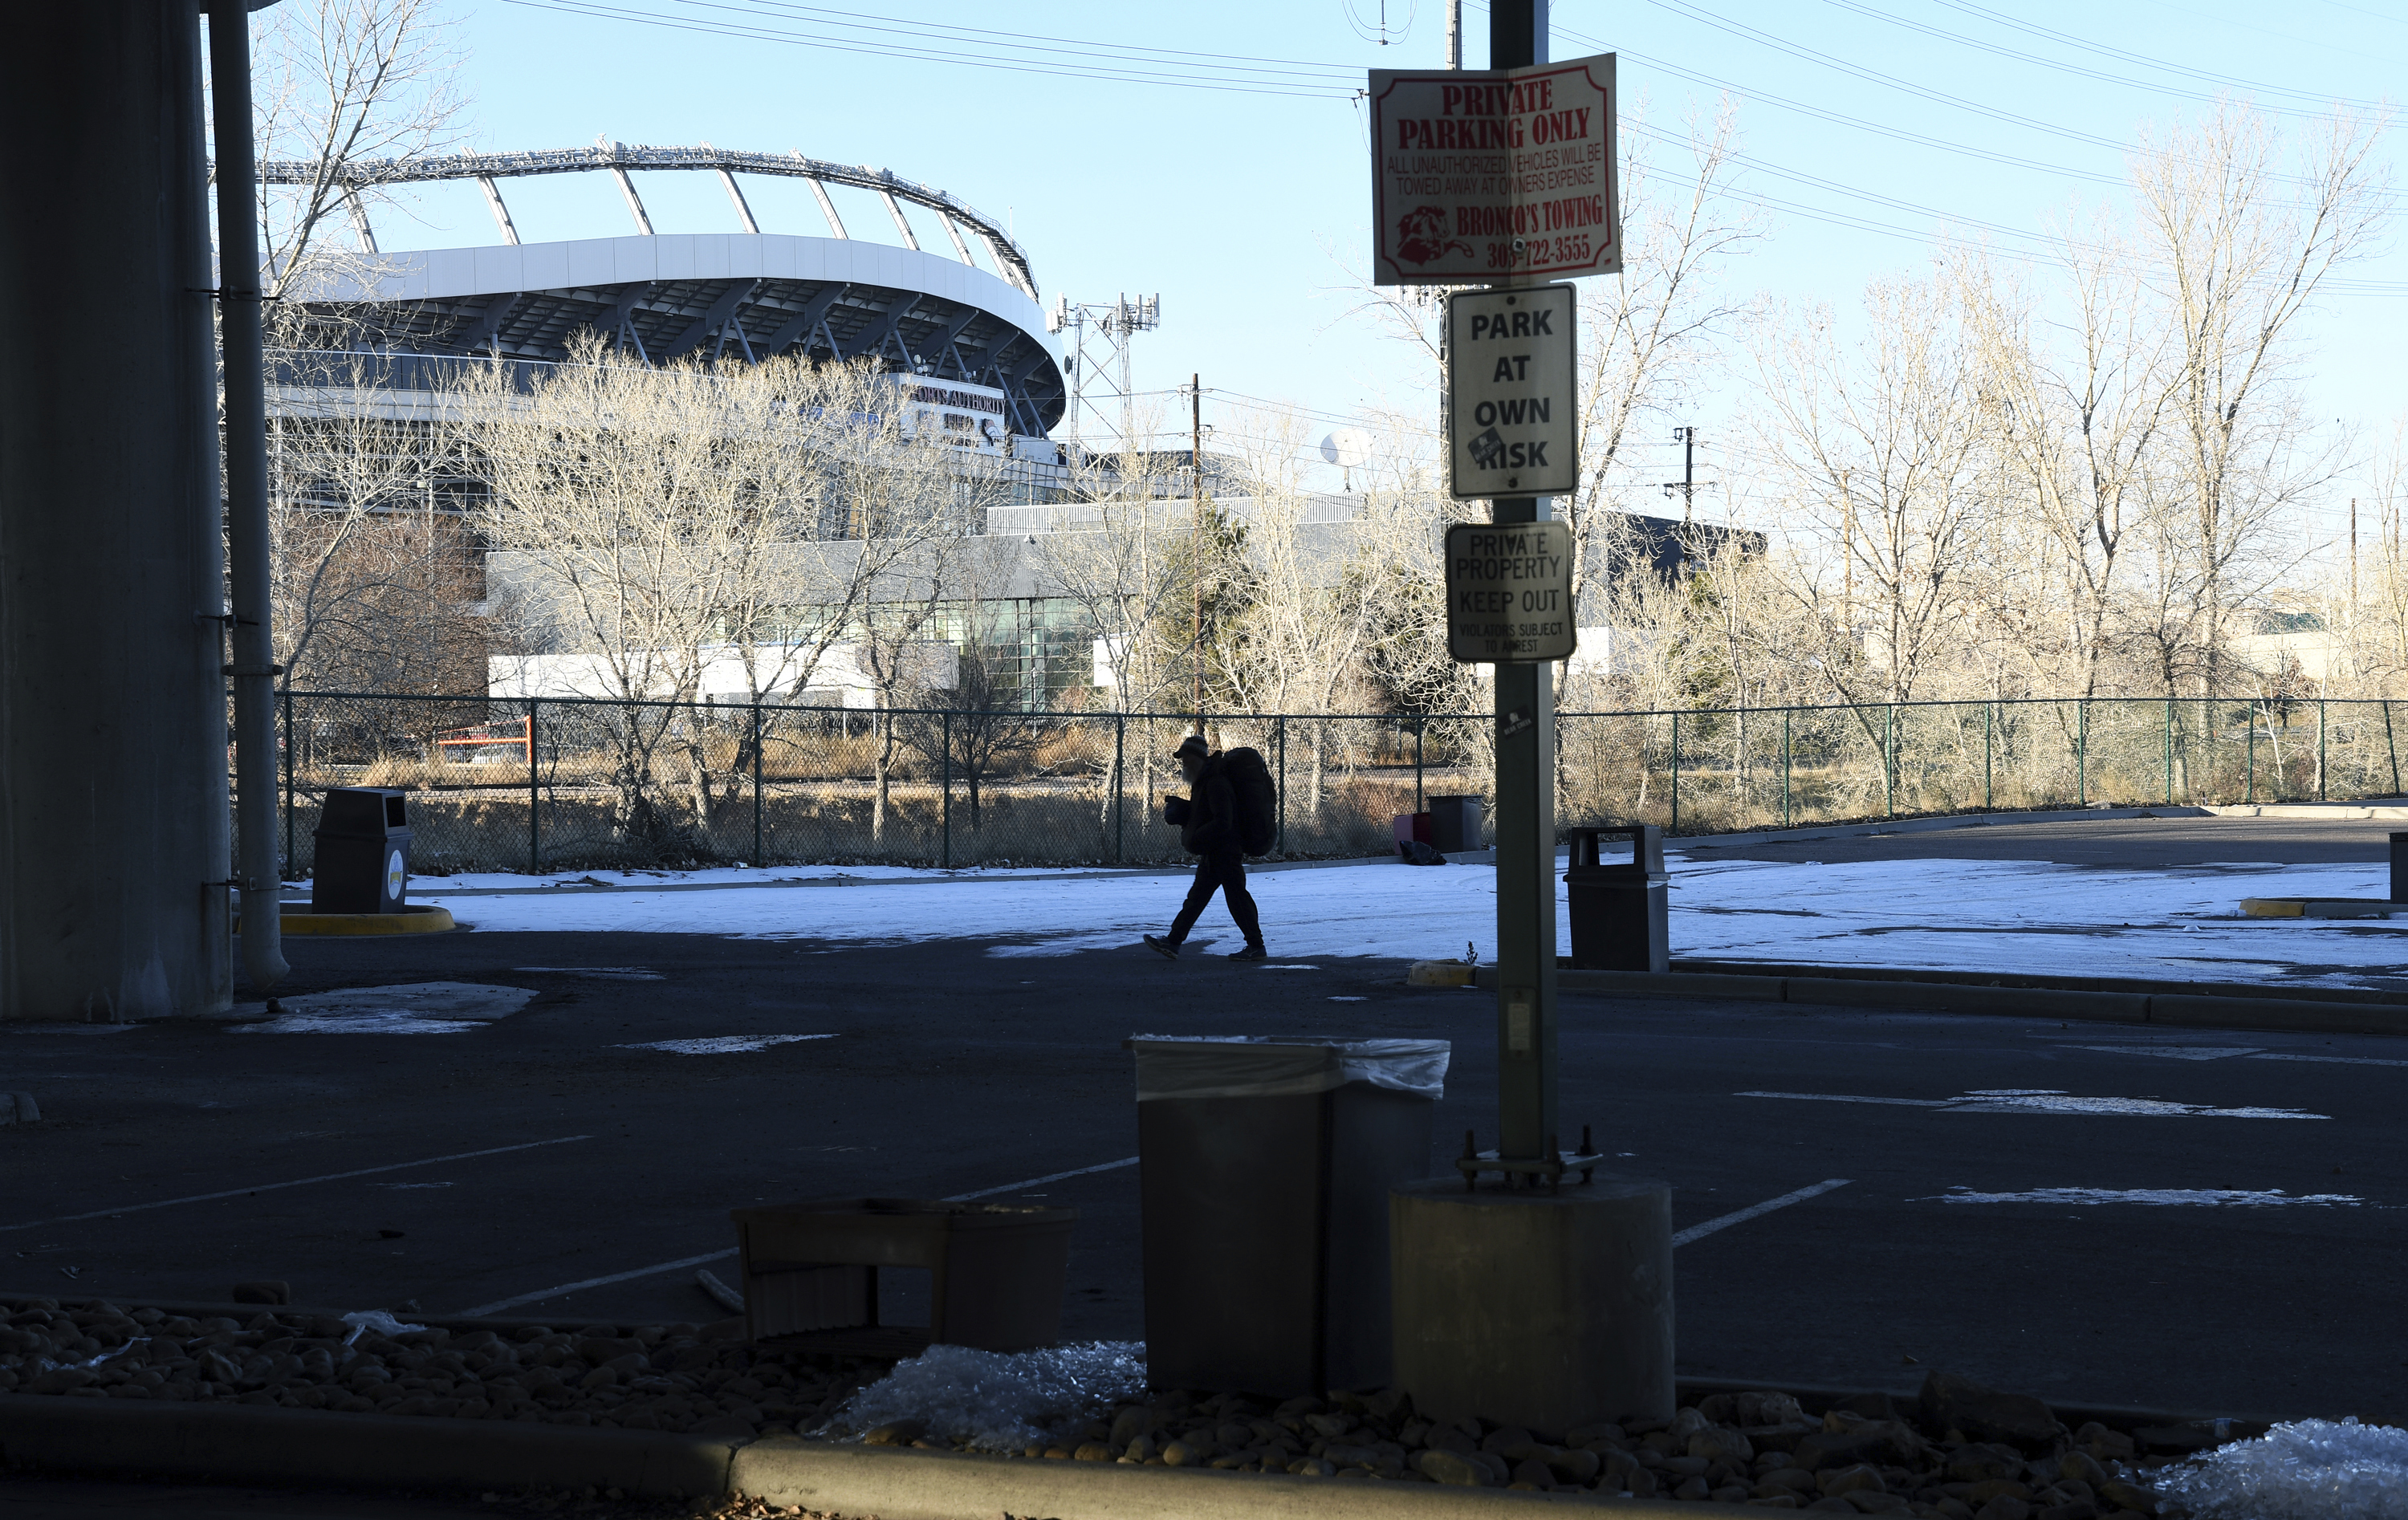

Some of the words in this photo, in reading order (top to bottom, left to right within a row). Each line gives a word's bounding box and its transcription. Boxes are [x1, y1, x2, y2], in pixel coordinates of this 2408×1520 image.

[1442, 79, 1552, 116] PRIVATE
[1398, 118, 1523, 150] PARKING
[1532, 107, 1590, 145] ONLY
[1387, 156, 1409, 173] ALL
[1413, 156, 1507, 173] UNAUTHORIZED
[1510, 149, 1559, 173] VEHICLES
[1561, 145, 1585, 165] WILL
[1588, 143, 1601, 161] BE
[1396, 177, 1442, 195] TOWED
[1446, 177, 1479, 195] AWAY
[1481, 177, 1496, 195] AT
[1499, 173, 1546, 195] OWNERS
[1548, 165, 1595, 189] EXPENSE
[1456, 202, 1539, 236] BRONCO'S
[1542, 193, 1603, 231] TOWING
[1487, 234, 1590, 268] 303-722-3555
[1471, 310, 1553, 340] PARK
[1493, 355, 1531, 383] AT
[901, 383, 949, 405] PORTS
[950, 389, 1007, 415] AUTHORITY
[1474, 397, 1550, 427] OWN
[945, 413, 975, 432] FIED
[1470, 533, 1548, 556] PRIVATE
[1456, 555, 1561, 580] PROPERTY
[1460, 591, 1514, 613] KEEP
[1523, 589, 1560, 612] OUT
[1459, 624, 1515, 637] VIOLATORS
[1519, 622, 1563, 636] SUBJECT
[1486, 640, 1498, 652] TO
